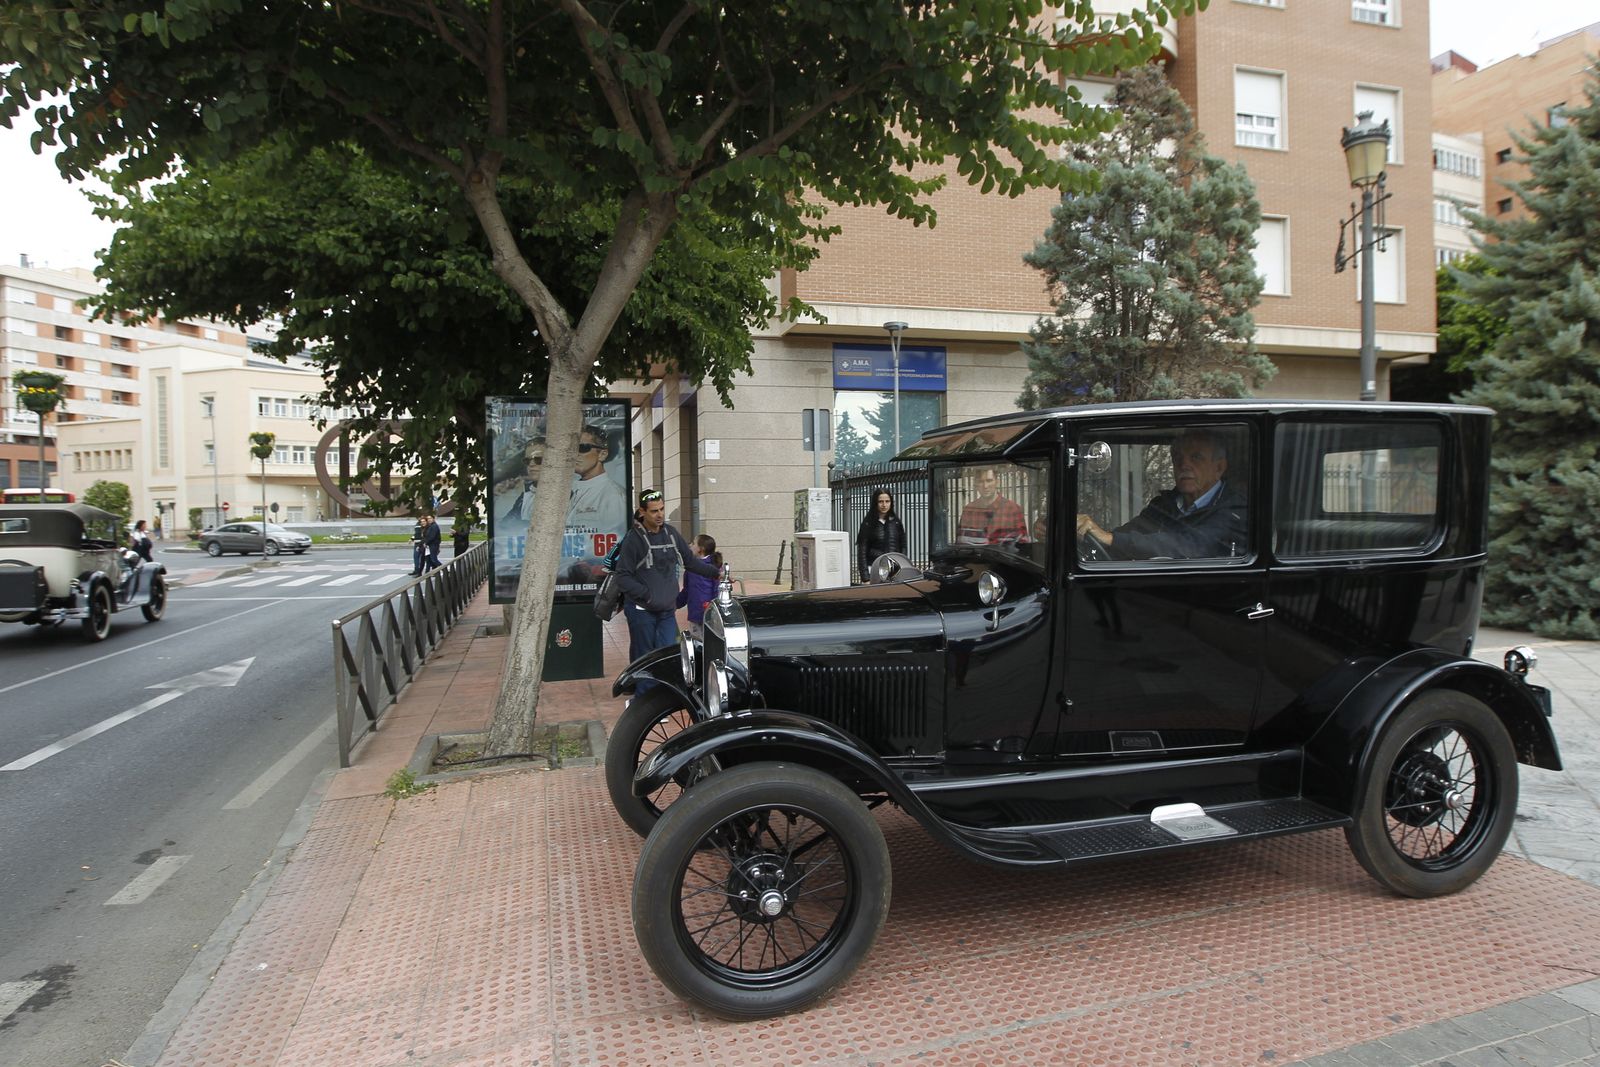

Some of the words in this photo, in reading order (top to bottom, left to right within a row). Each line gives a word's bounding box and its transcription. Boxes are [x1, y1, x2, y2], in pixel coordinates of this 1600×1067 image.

[507, 534, 526, 559] LE
[590, 533, 618, 557] '66
[582, 583, 598, 591] CINES
